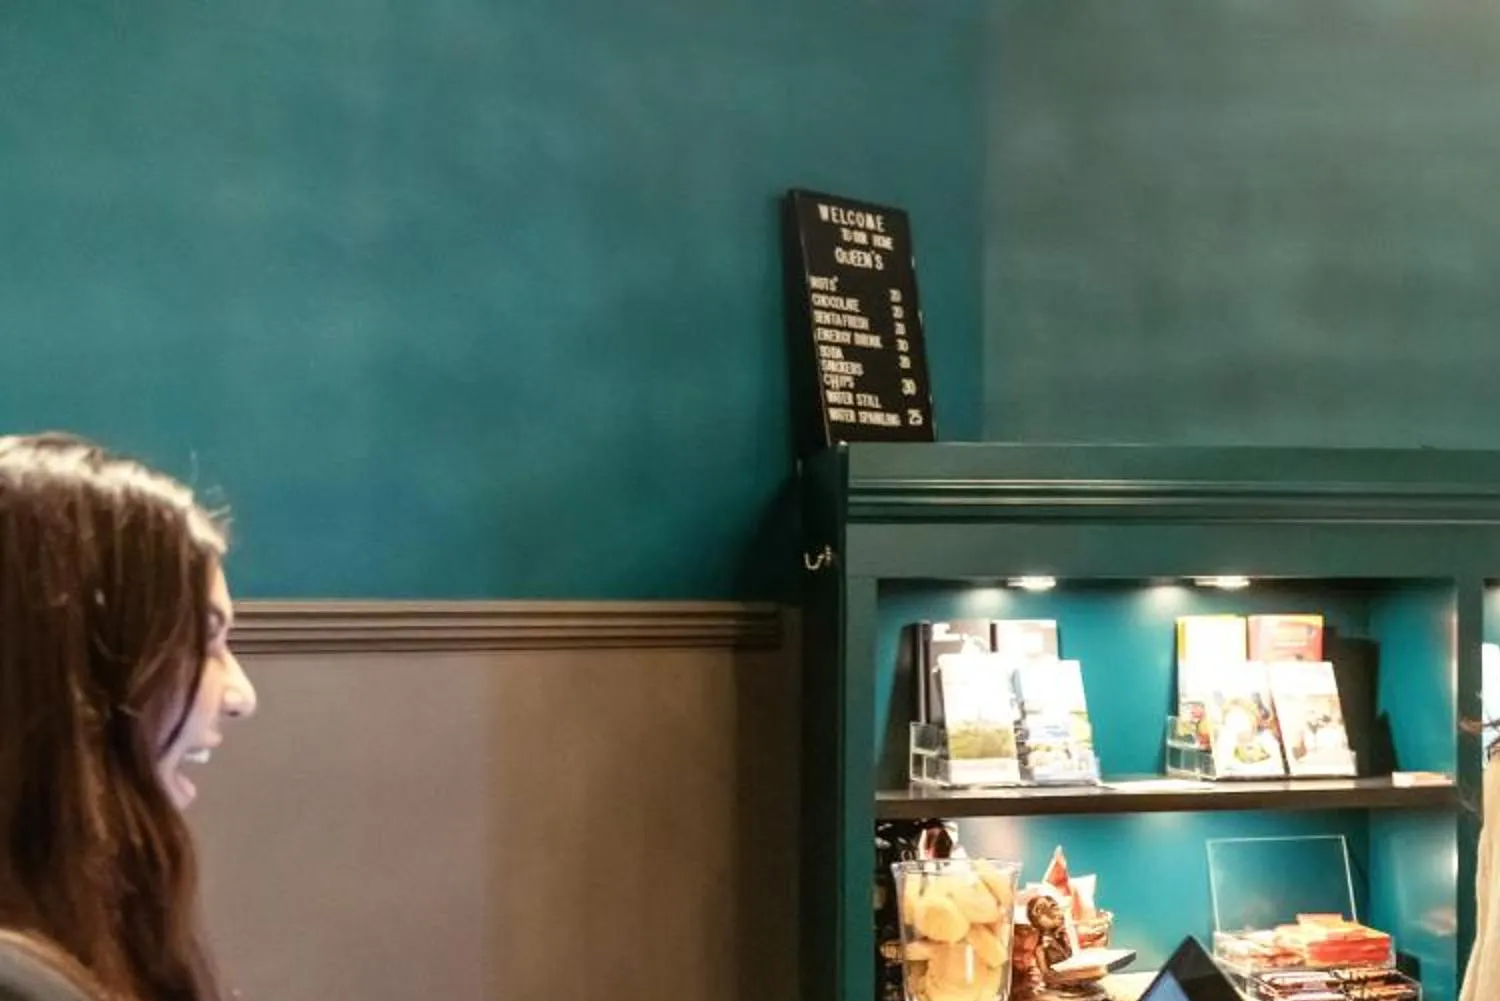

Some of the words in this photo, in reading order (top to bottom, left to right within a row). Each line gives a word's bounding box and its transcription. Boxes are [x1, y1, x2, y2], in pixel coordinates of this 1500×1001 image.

[817, 203, 885, 233] WELCOME
[834, 246, 884, 271] QUEEN'S
[811, 292, 861, 313] CHOCOLATE
[823, 373, 855, 391] CHIPS
[856, 393, 882, 409] STILL
[907, 408, 922, 426] 25
